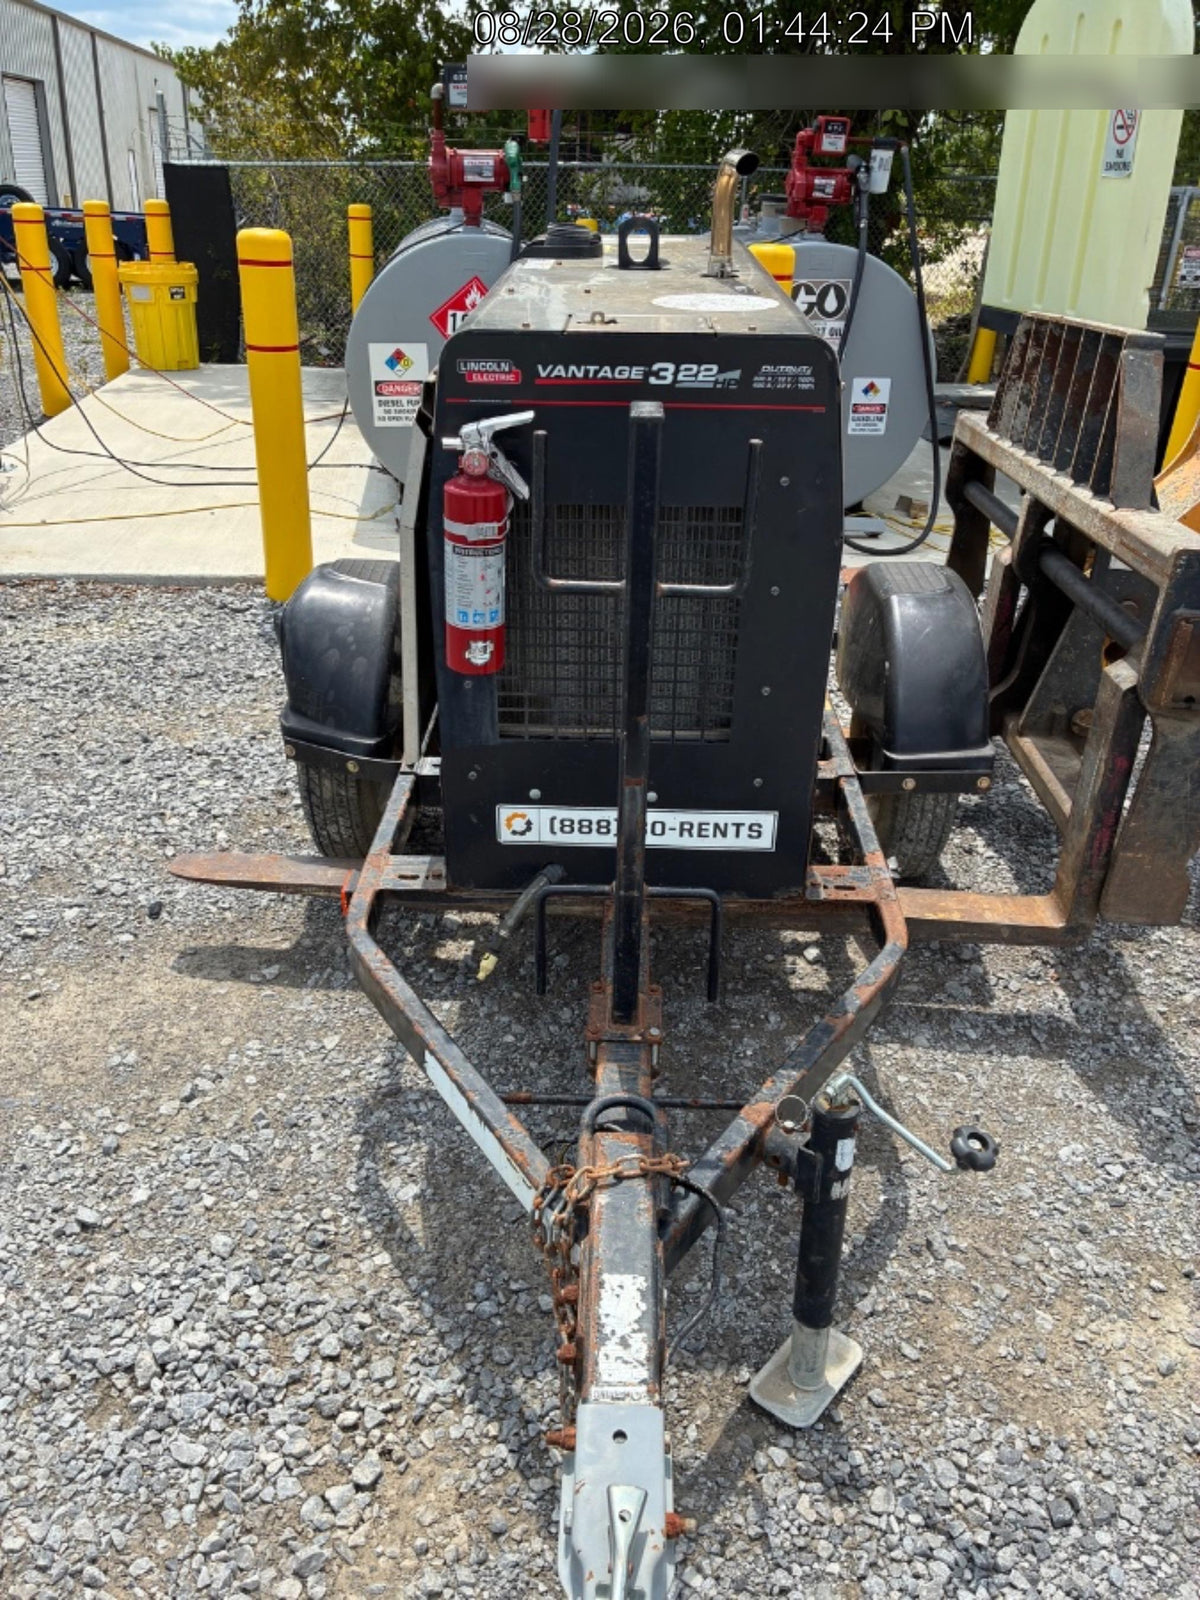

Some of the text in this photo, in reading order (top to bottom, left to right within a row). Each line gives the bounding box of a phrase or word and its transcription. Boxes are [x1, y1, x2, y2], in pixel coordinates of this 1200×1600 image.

[460, 362, 509, 371] LINCOLN
[472, 373, 516, 382] ELECTRIC
[536, 364, 645, 380] VANTAGE
[649, 361, 719, 385] 322
[378, 399, 404, 408] DIESEL
